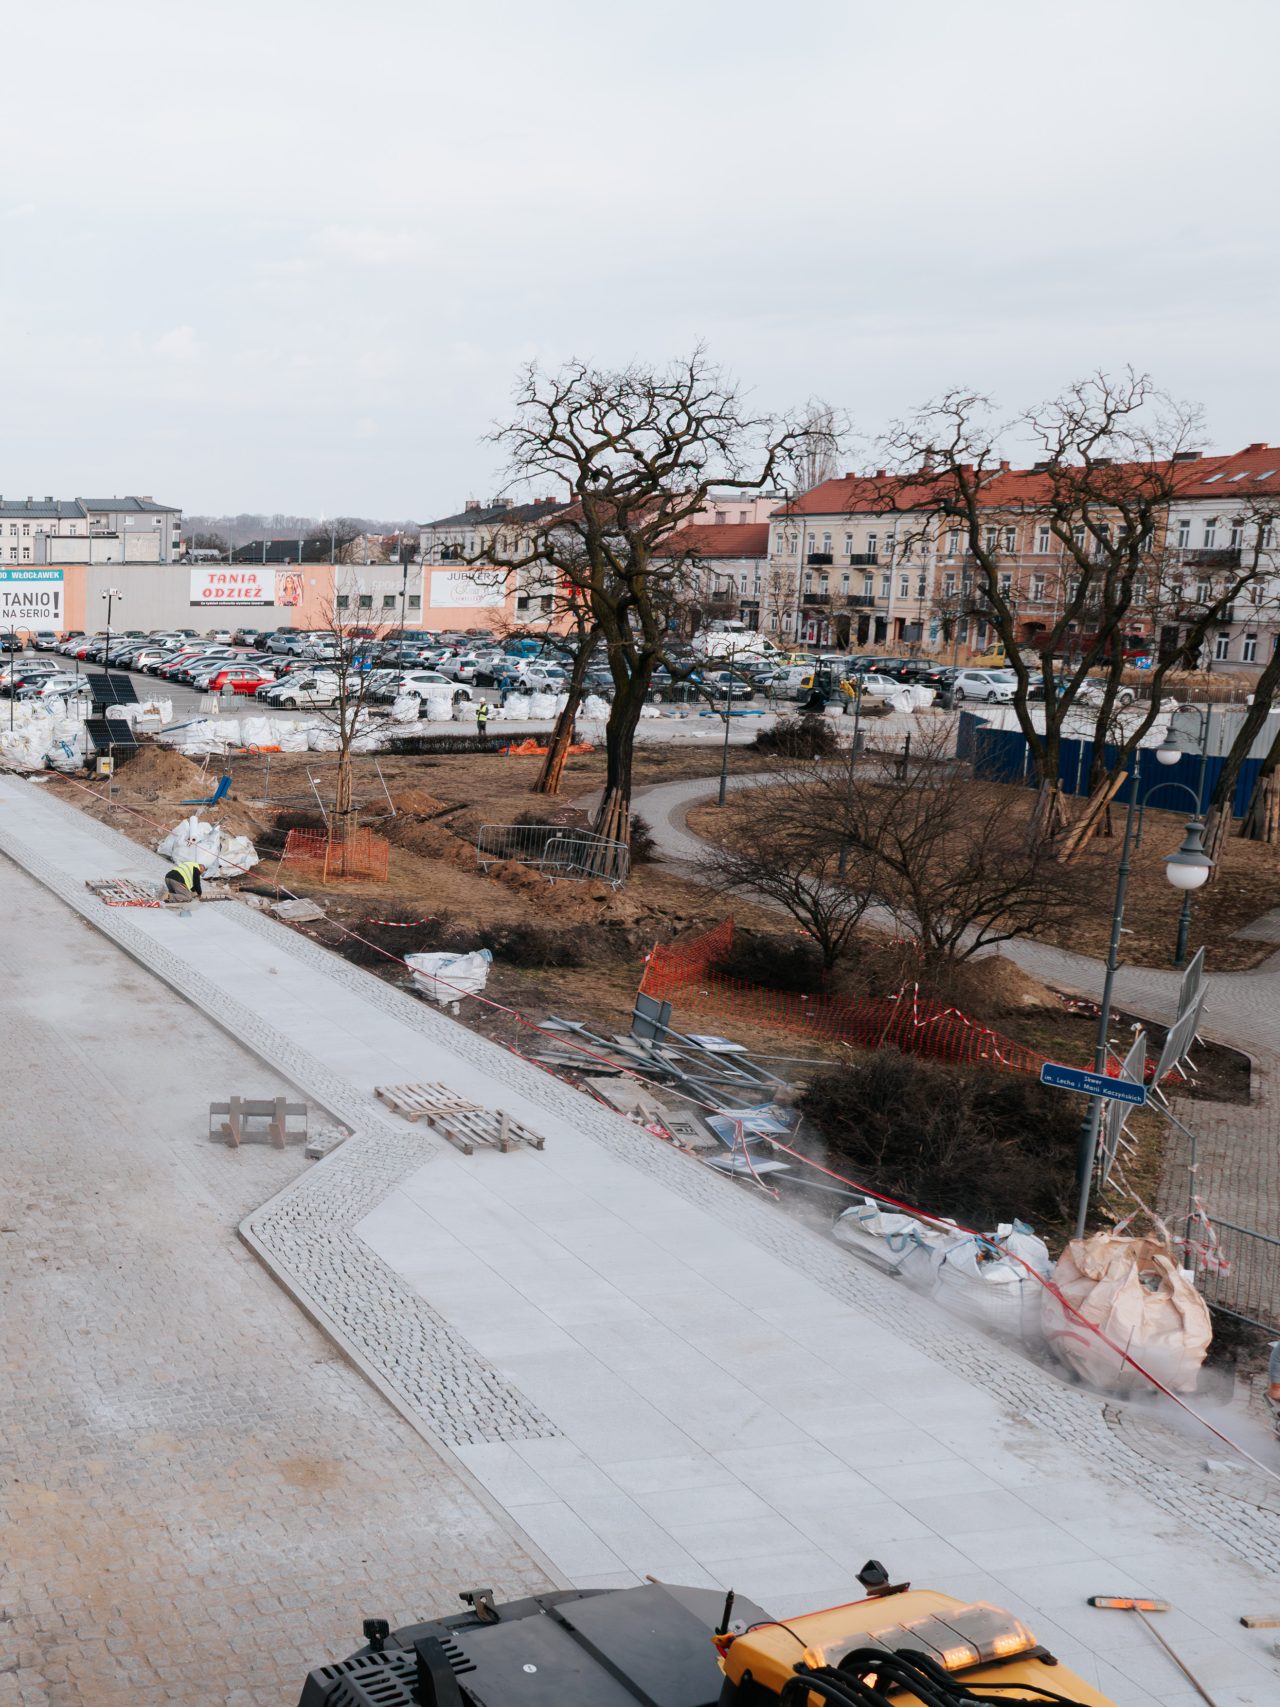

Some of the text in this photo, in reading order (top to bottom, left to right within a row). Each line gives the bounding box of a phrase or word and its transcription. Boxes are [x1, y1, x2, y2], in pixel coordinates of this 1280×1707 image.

[12, 571, 60, 579] WŁOCŁAWEK
[208, 574, 257, 584] TANIA
[202, 585, 262, 598] ODZIEŻ
[2, 608, 50, 618] NA SERIO
[1084, 1076, 1102, 1085] Skwer
[1056, 1077, 1075, 1087] Lecha
[1083, 1083, 1100, 1092] Marii
[1103, 1088, 1142, 1101] Kaczyńskich
